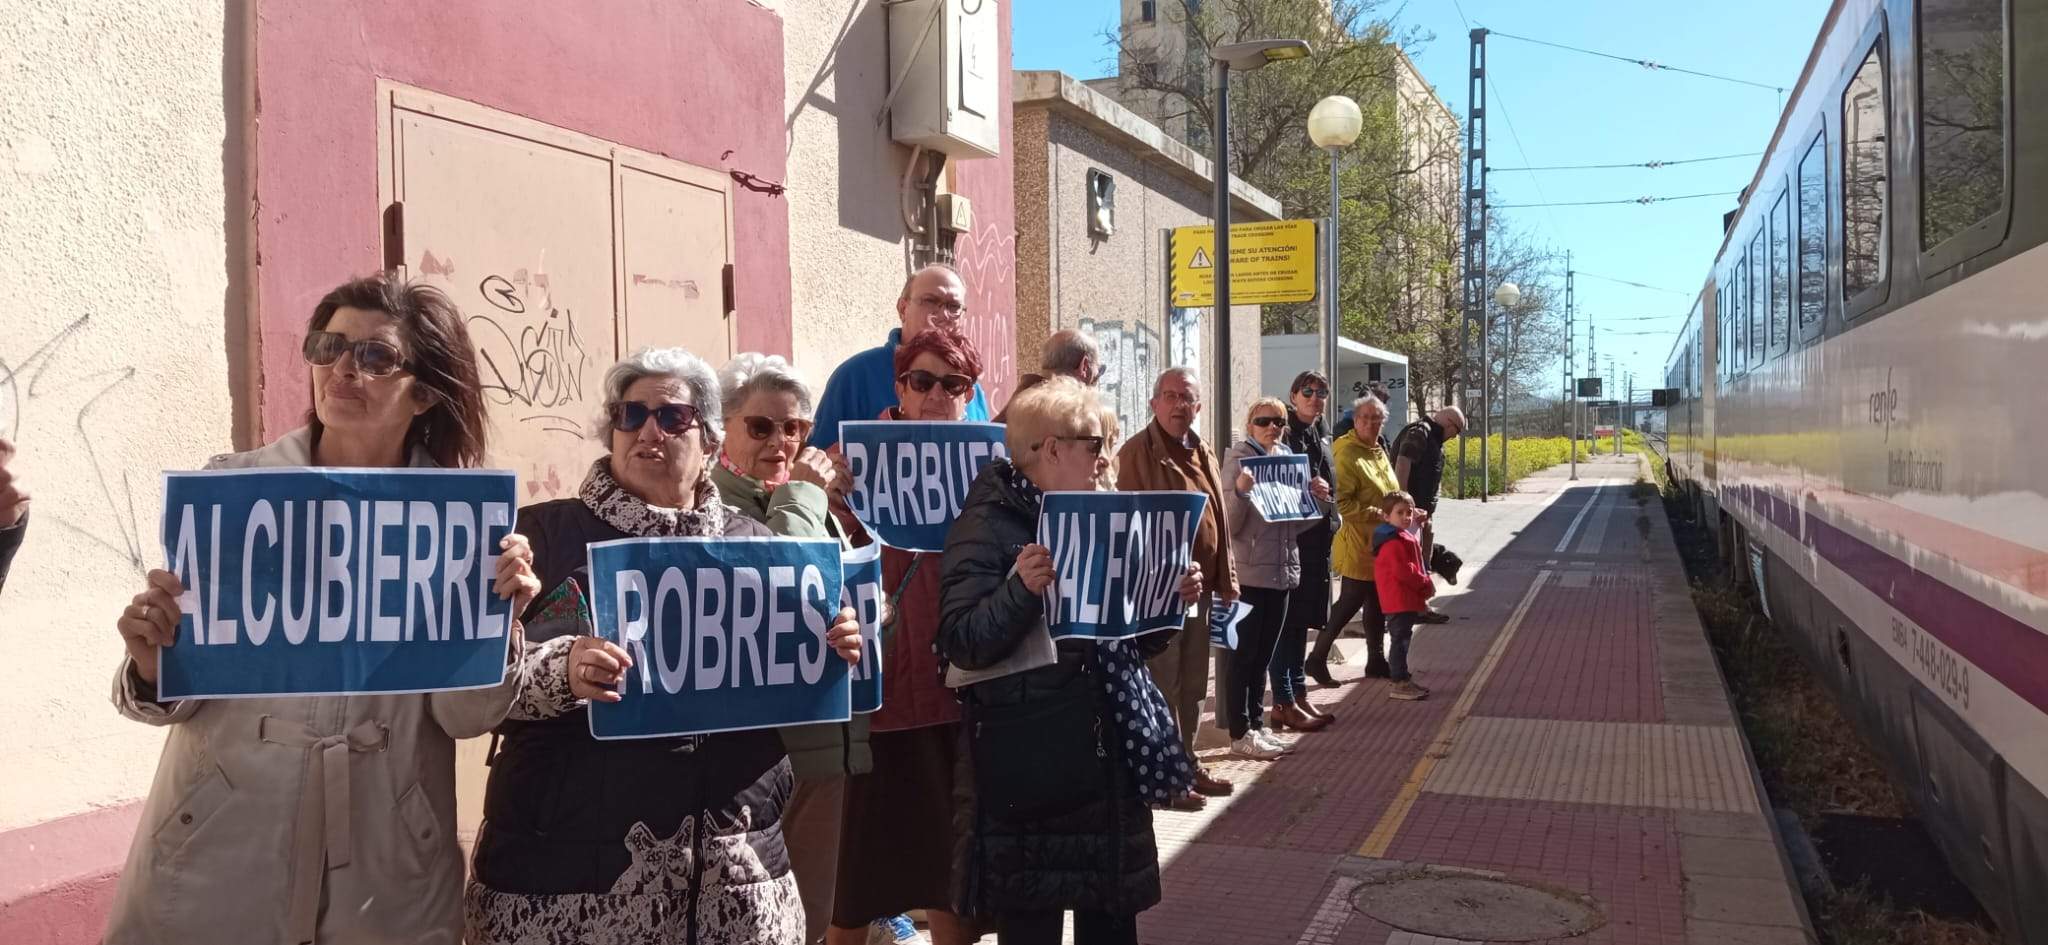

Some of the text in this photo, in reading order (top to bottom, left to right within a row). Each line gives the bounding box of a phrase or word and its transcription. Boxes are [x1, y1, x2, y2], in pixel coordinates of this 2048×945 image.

[1869, 367, 1897, 444] renfe
[174, 498, 509, 646] ALCUBIERRE
[615, 564, 827, 696] ROBRES
[1042, 510, 1191, 626] VALFONDA
